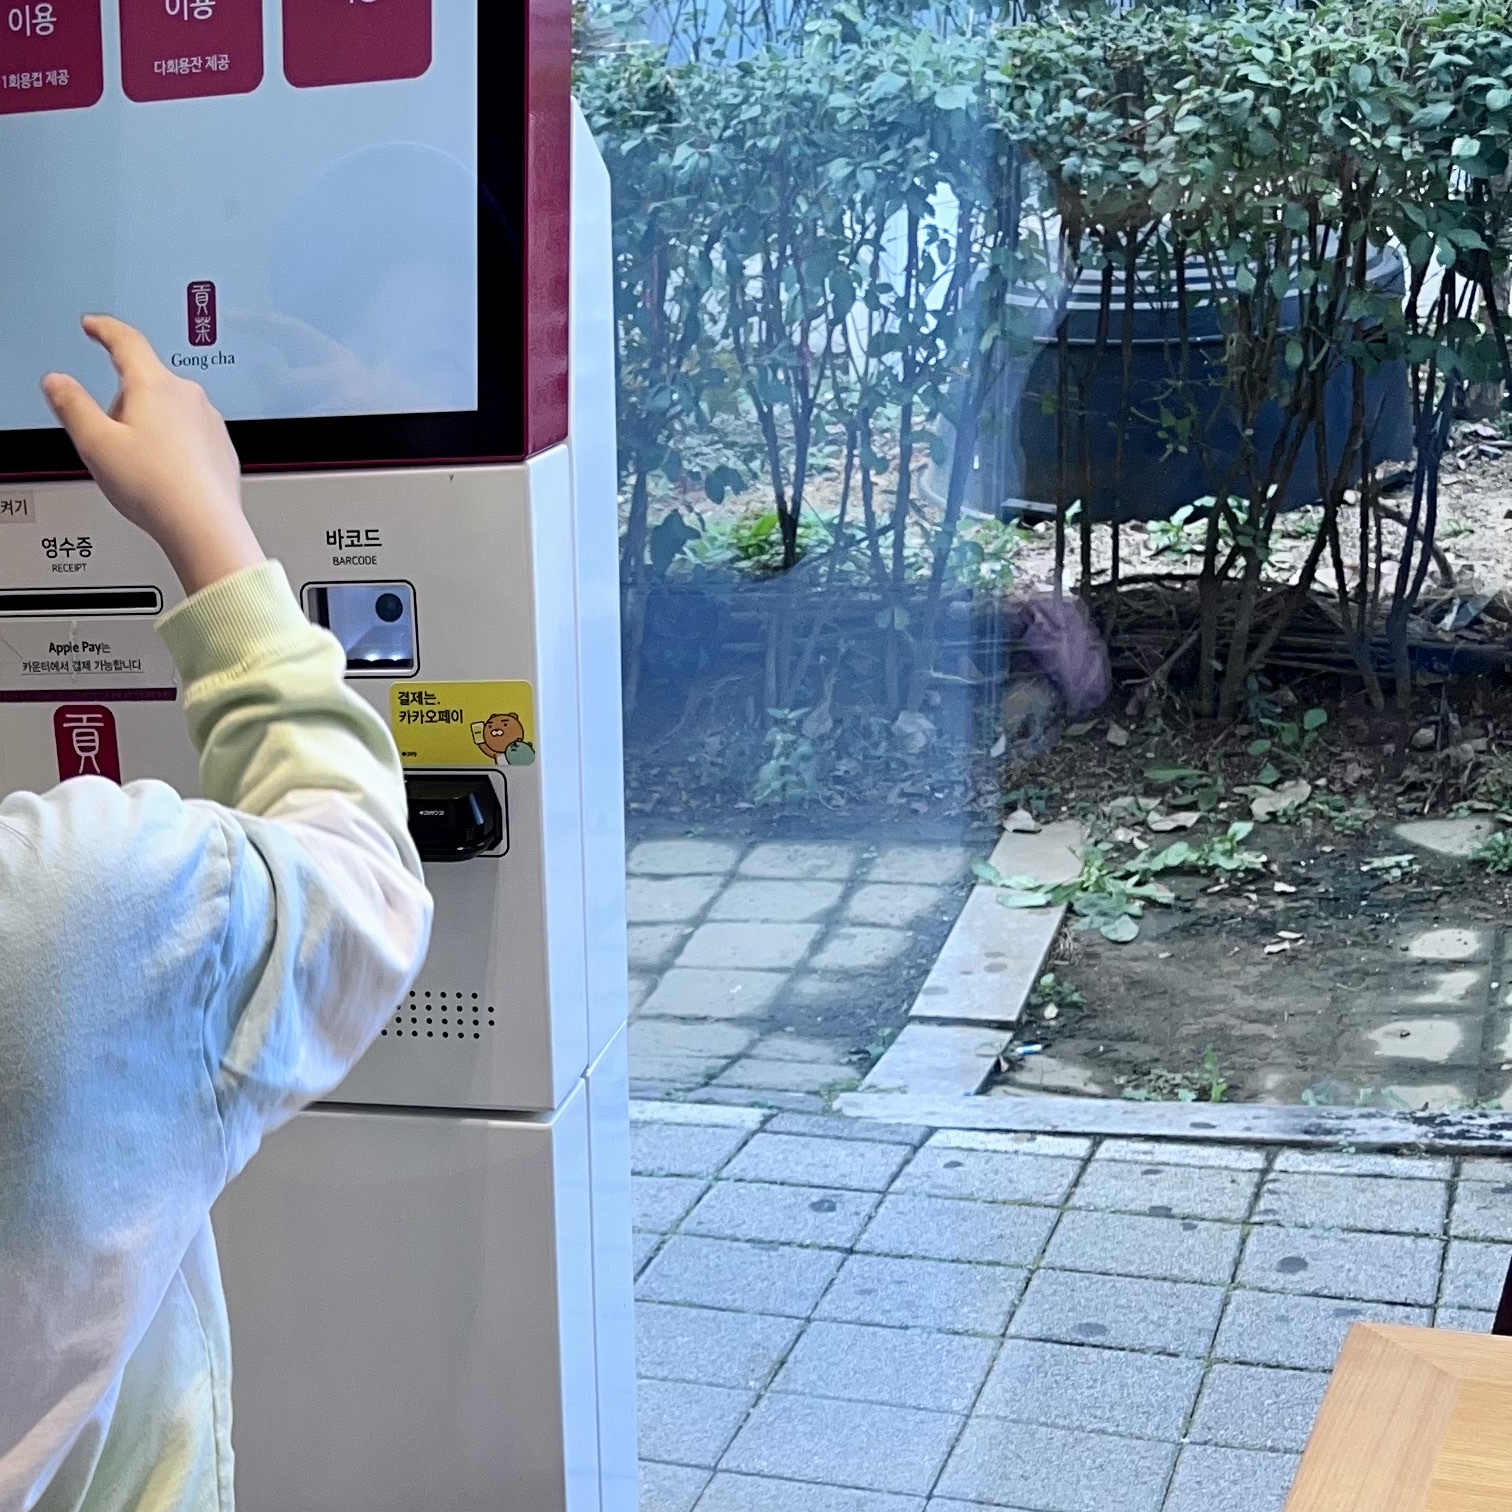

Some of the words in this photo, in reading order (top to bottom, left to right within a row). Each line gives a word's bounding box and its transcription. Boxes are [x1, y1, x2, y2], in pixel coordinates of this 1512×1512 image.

[8, 3, 57, 37] 이용
[153, 56, 203, 76] 다회용잔
[204, 54, 230, 72] 제공
[1, 72, 43, 91] 1회용컵
[45, 69, 70, 87] 제공
[171, 352, 208, 370] Gong
[211, 350, 236, 365] cha
[41, 536, 93, 559] 영수증
[326, 528, 383, 551] 바코드
[51, 562, 88, 573] RECEIPT
[332, 555, 378, 566] BARCODE
[49, 641, 79, 656] Apple
[82, 640, 111, 656] Pay는
[22, 659, 69, 673] 카운터에서
[72, 659, 91, 672] 결제
[94, 658, 142, 672] 가능합니다
[399, 709, 464, 725] 카카오페이
